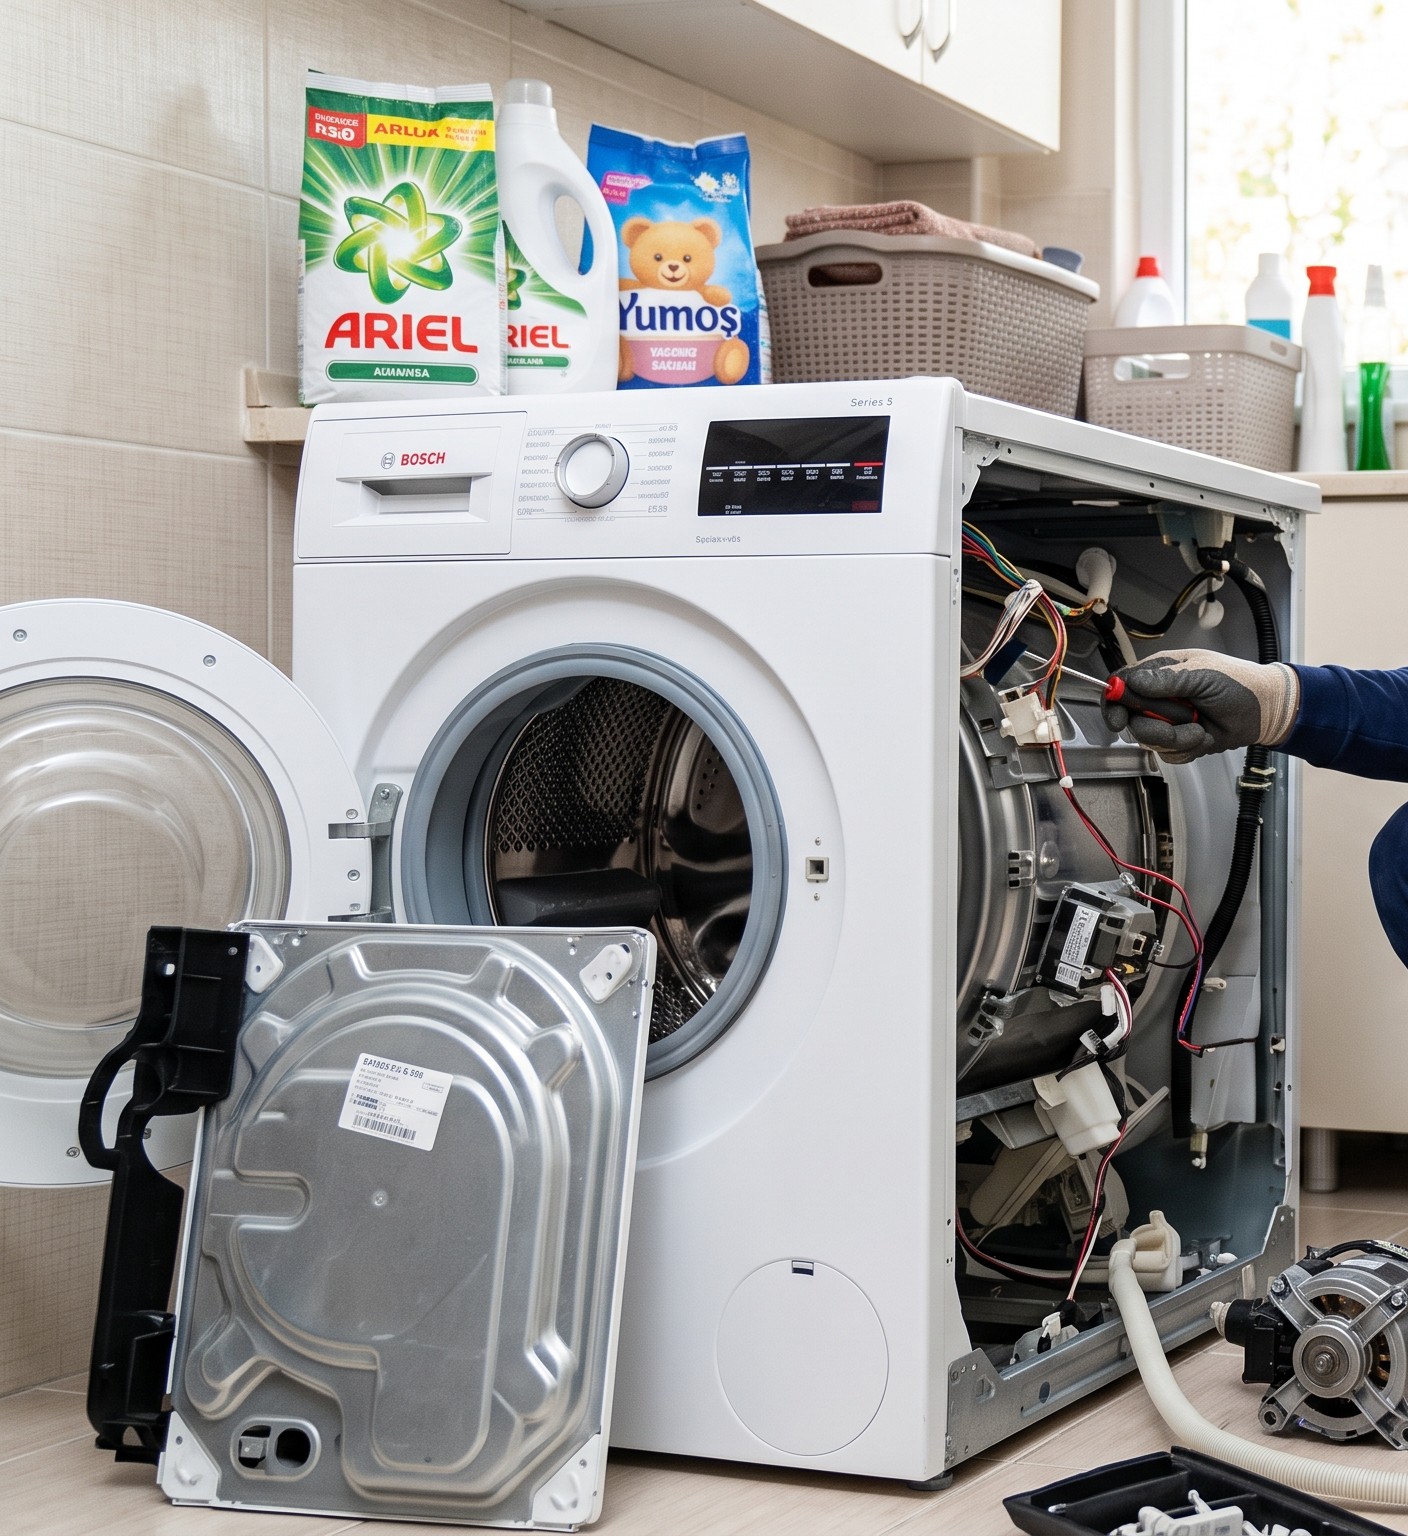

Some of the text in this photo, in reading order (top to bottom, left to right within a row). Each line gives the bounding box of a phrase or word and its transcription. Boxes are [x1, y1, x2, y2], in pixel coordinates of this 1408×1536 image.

[619, 292, 739, 338] Yumoş
[324, 312, 478, 353] ARIEL
[507, 325, 569, 348] RIEL
[850, 397, 883, 407] Series
[400, 451, 446, 466] BOSCH
